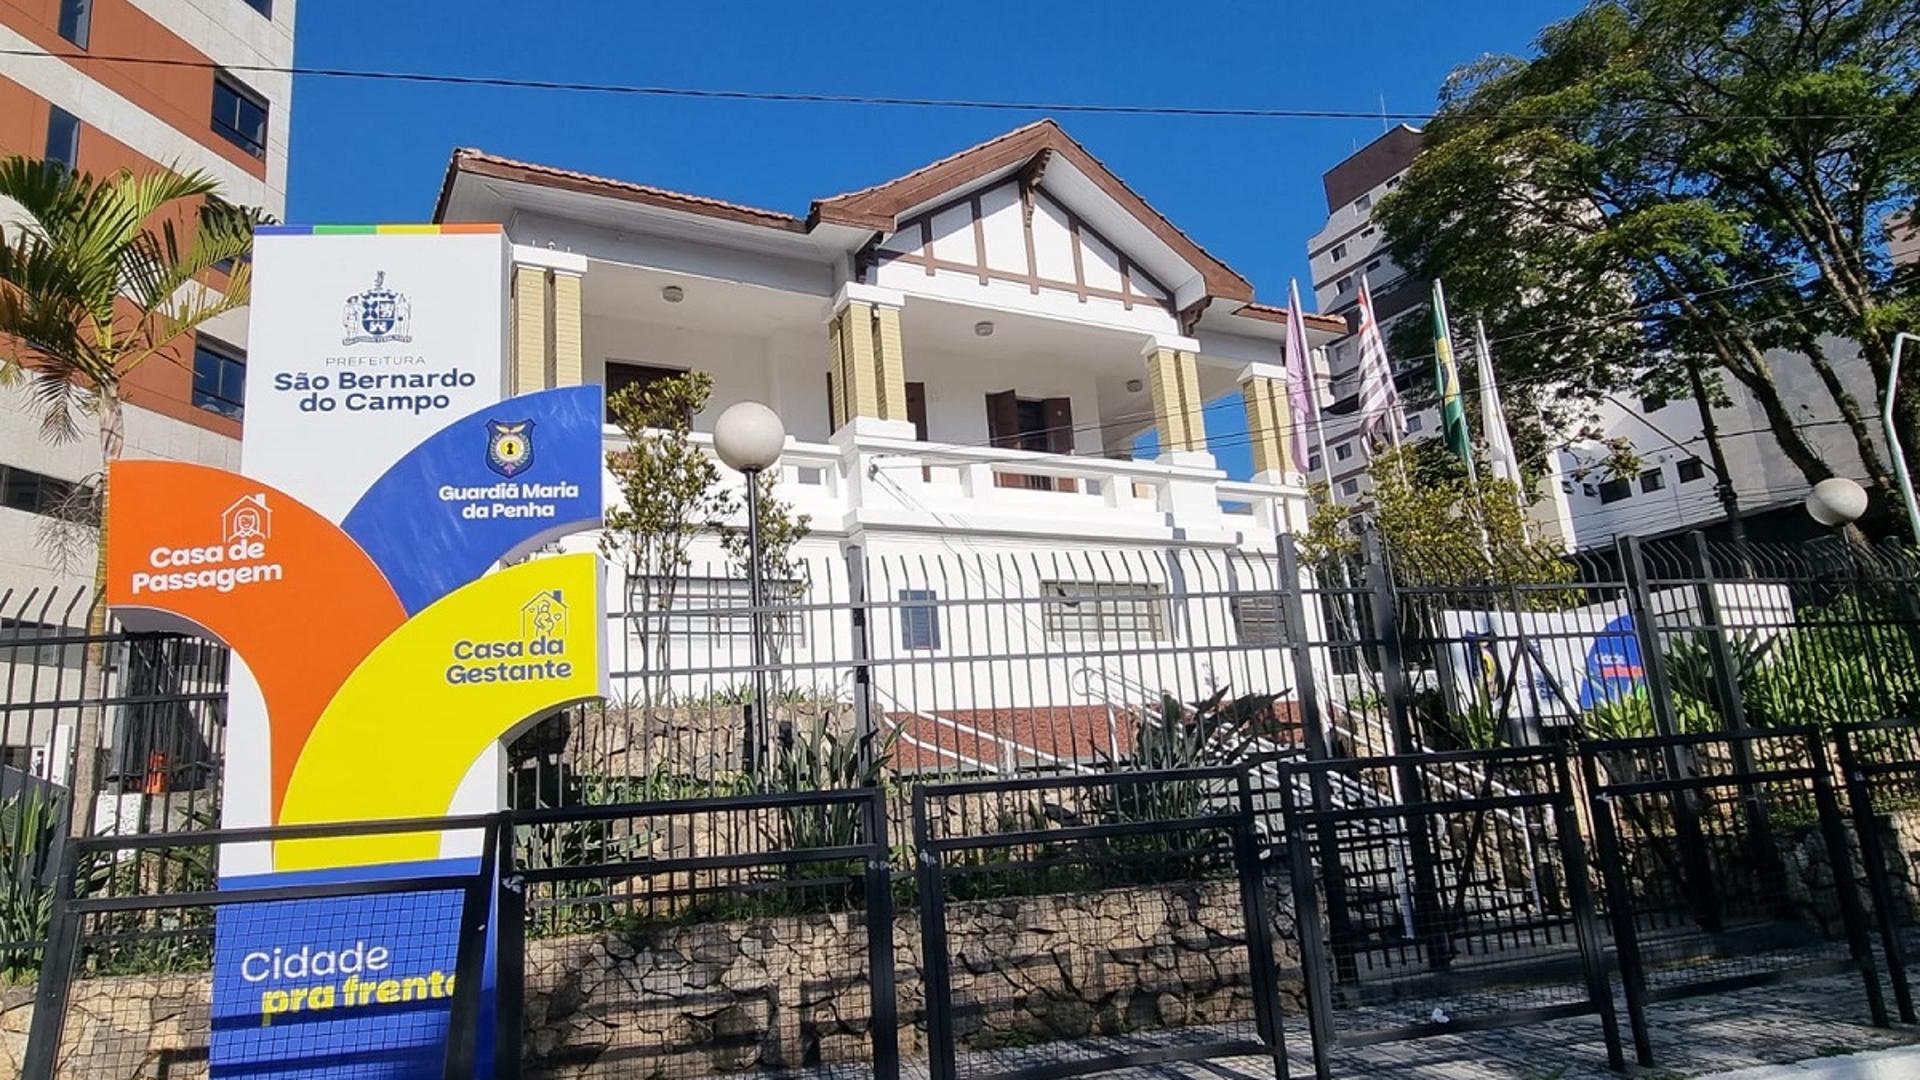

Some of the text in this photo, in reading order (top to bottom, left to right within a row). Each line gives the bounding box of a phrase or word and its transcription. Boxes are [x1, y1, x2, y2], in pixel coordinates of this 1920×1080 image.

[326, 355, 426, 367] PREFEITURA
[274, 367, 476, 391] São Bernardo
[299, 392, 450, 415] do Campo
[438, 481, 579, 501] Guardiã Maria
[462, 502, 555, 519] da Penha
[150, 539, 265, 568] Casa de
[132, 563, 283, 594] Passagem
[454, 635, 564, 660] Casa da
[446, 659, 572, 685] Gestante
[241, 940, 389, 982] Cidade
[261, 982, 336, 1027] pra
